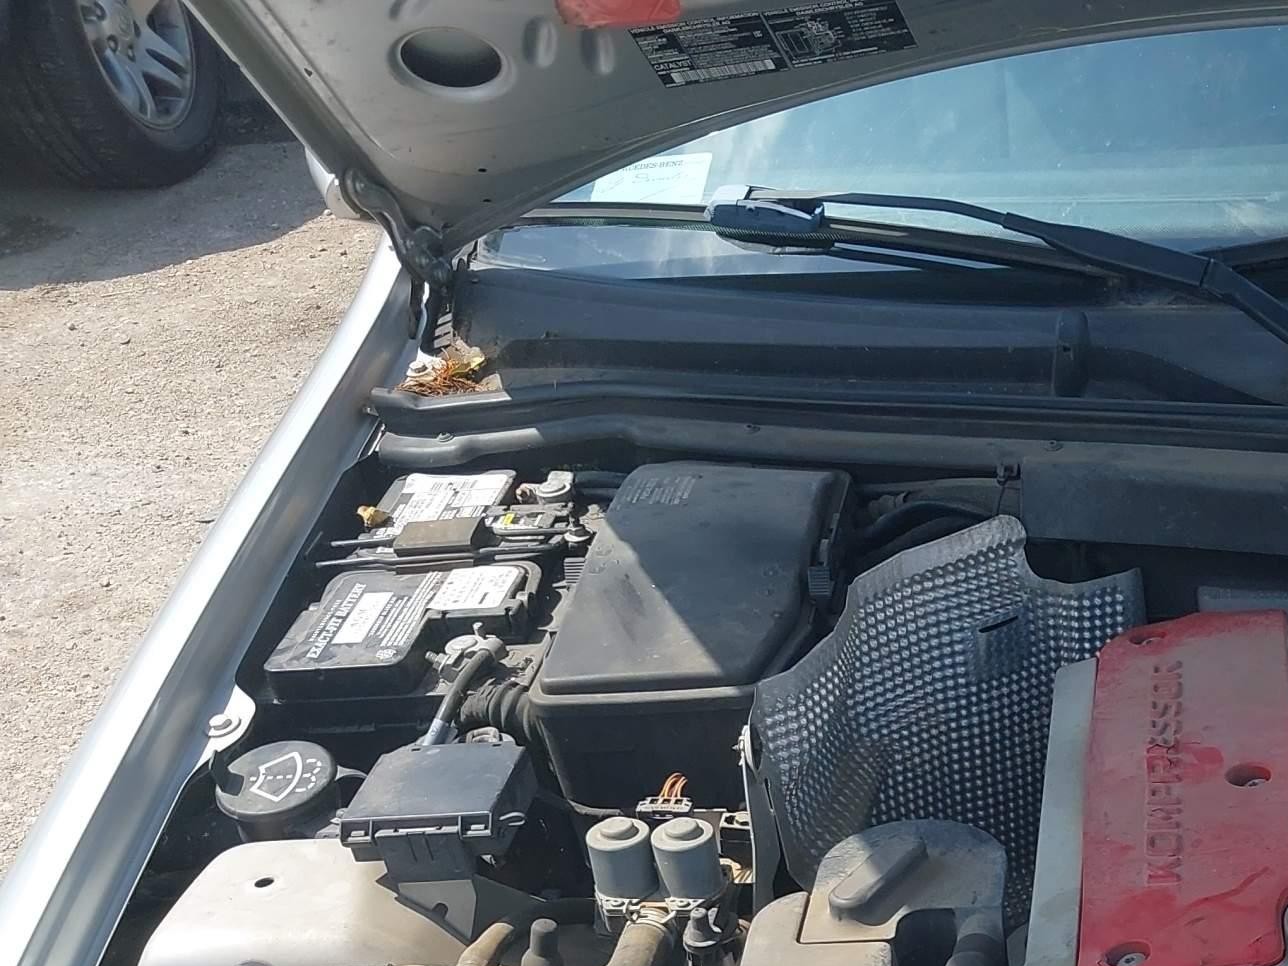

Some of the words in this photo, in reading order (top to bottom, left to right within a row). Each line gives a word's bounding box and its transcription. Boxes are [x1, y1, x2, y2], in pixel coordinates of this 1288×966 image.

[653, 60, 692, 72] CATALYST
[333, 582, 367, 617] BATTERY
[1145, 659, 1185, 887] KOMPRESSOR
